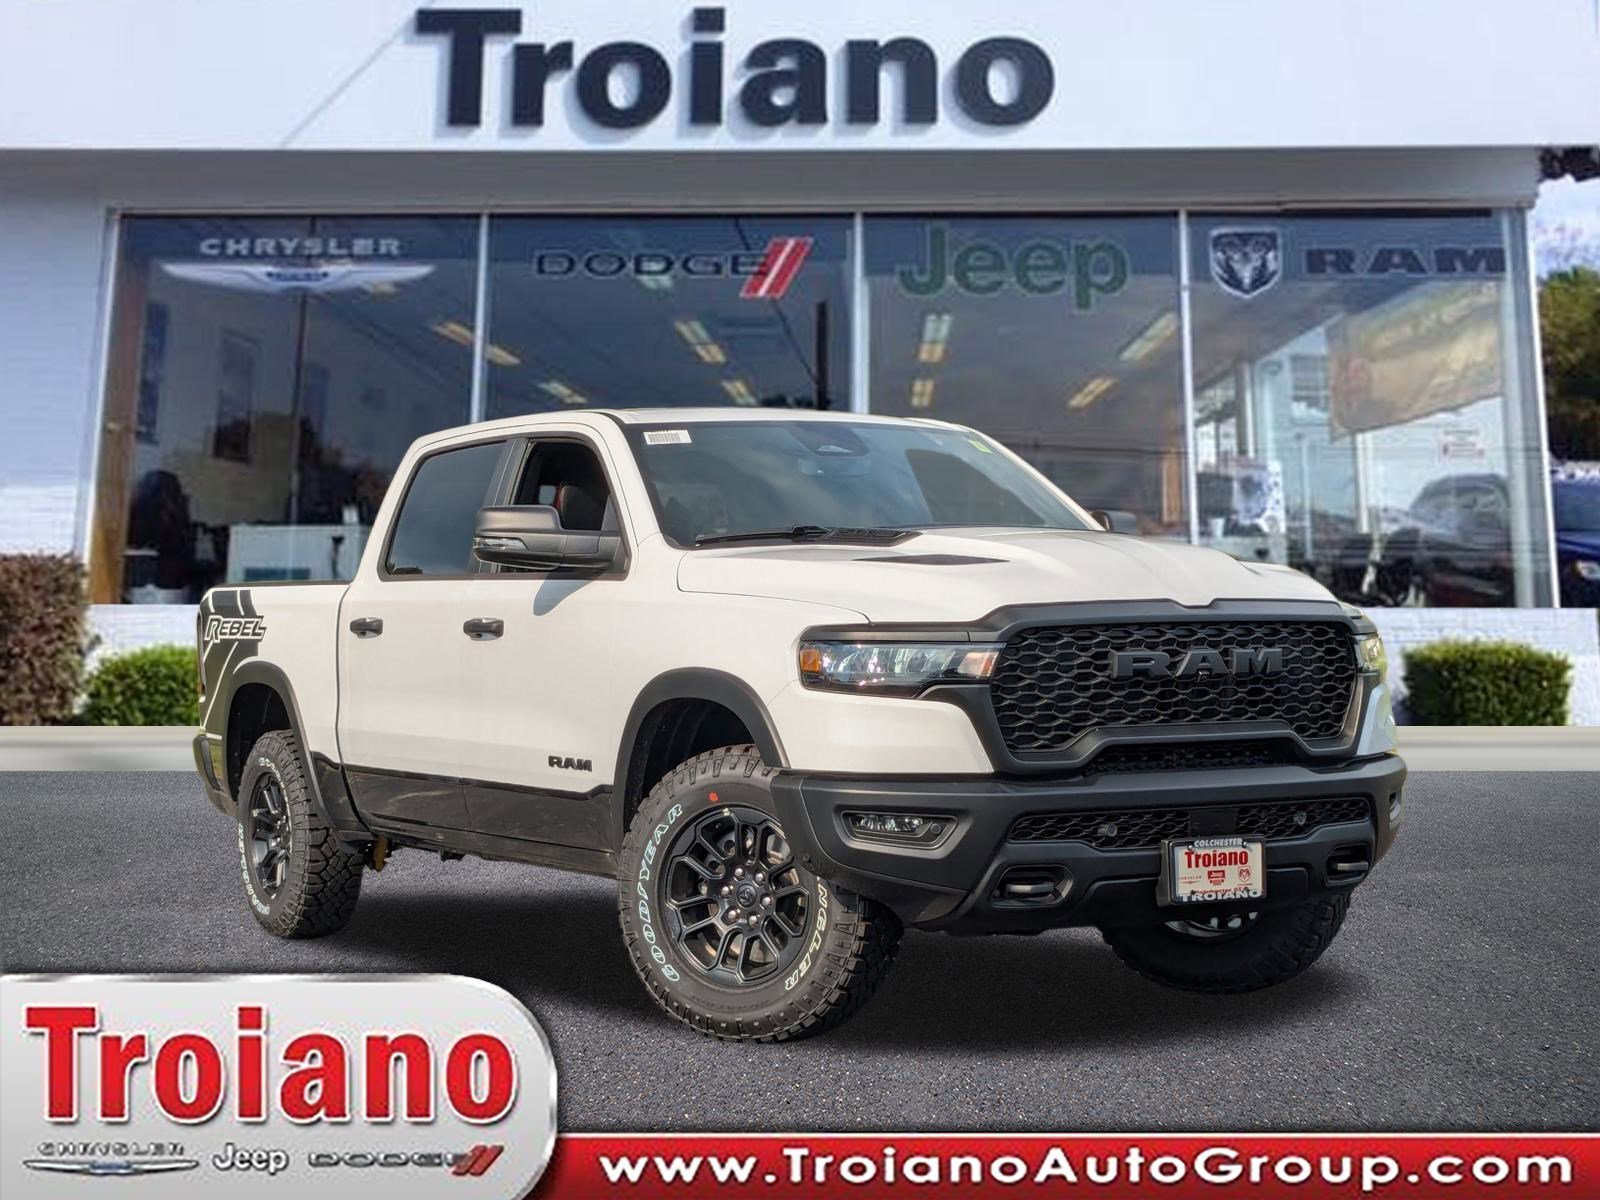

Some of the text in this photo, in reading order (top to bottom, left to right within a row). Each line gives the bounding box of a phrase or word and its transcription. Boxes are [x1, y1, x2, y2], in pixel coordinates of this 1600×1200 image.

[416, 7, 1055, 129] Troiano
[200, 237, 401, 256] CHRYSLER
[536, 253, 768, 276] DODGE
[897, 222, 1129, 310] Jeep
[1306, 248, 1507, 273] RAM
[204, 615, 268, 643] REBEL
[1108, 648, 1282, 678] RAM
[548, 755, 592, 772] RAM
[1194, 838, 1242, 849] COLCHESTER
[1184, 849, 1249, 868] Troiano
[637, 803, 683, 982] GOODYEAR
[1181, 889, 1262, 902] TROIANO
